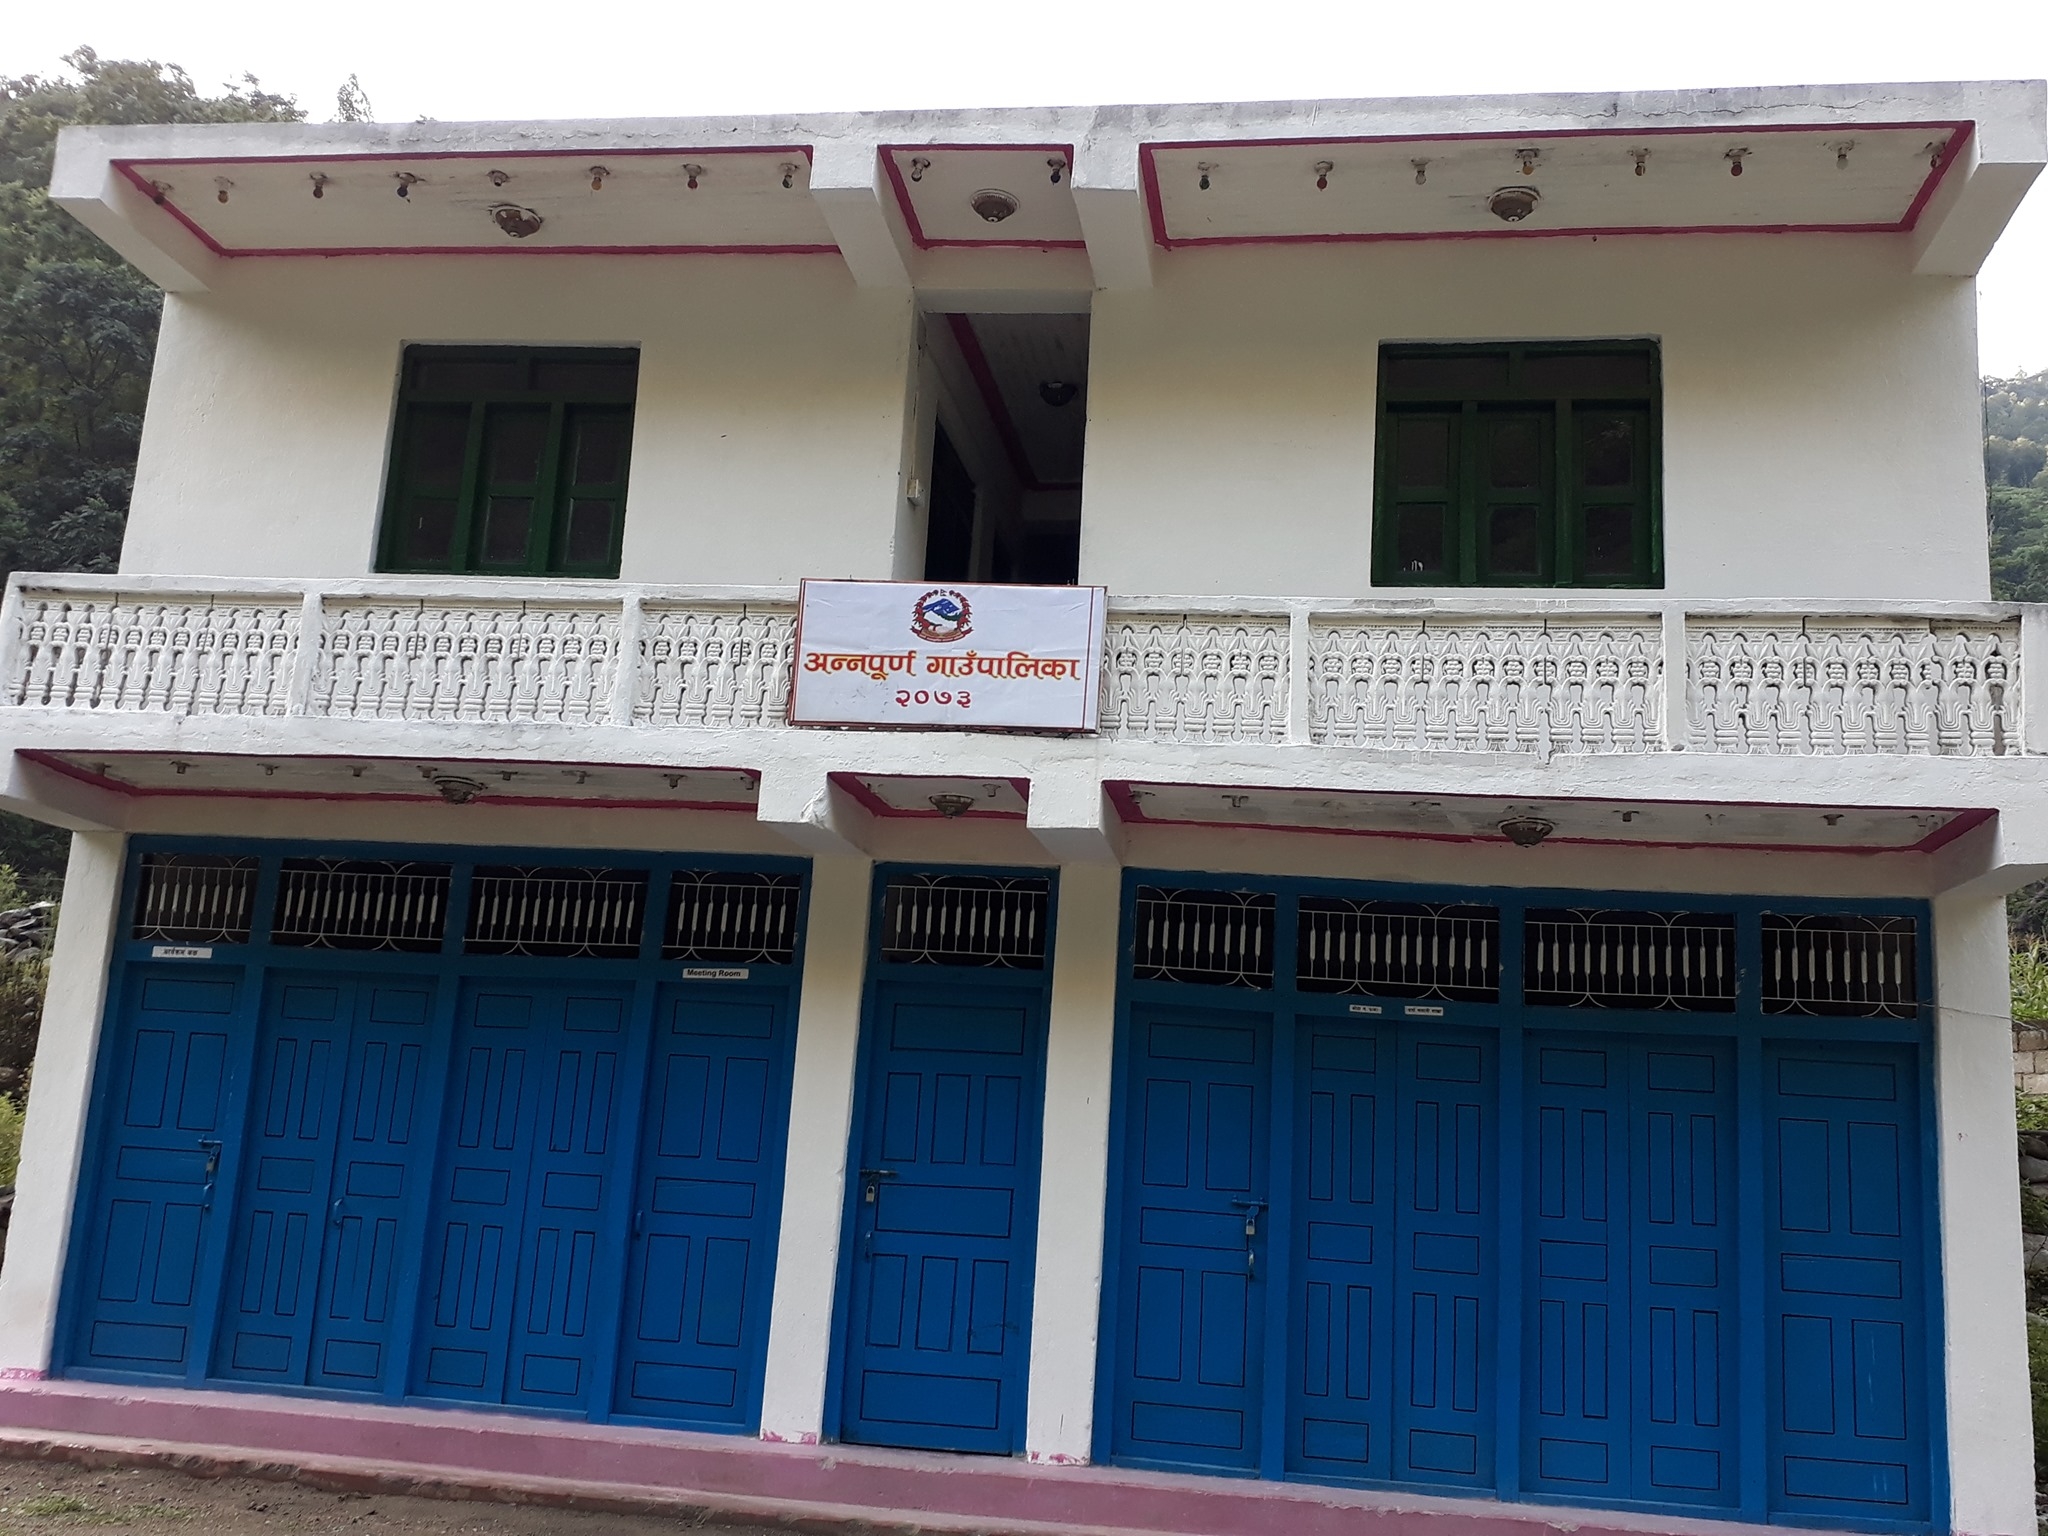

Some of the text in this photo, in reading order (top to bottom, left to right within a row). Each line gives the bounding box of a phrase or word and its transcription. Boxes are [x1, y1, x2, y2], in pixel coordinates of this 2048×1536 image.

[803, 650, 1081, 680] अन्नपूर्ण गाउँपालिका
[895, 689, 972, 709] २०७३
[687, 969, 741, 978] Meeting Room
